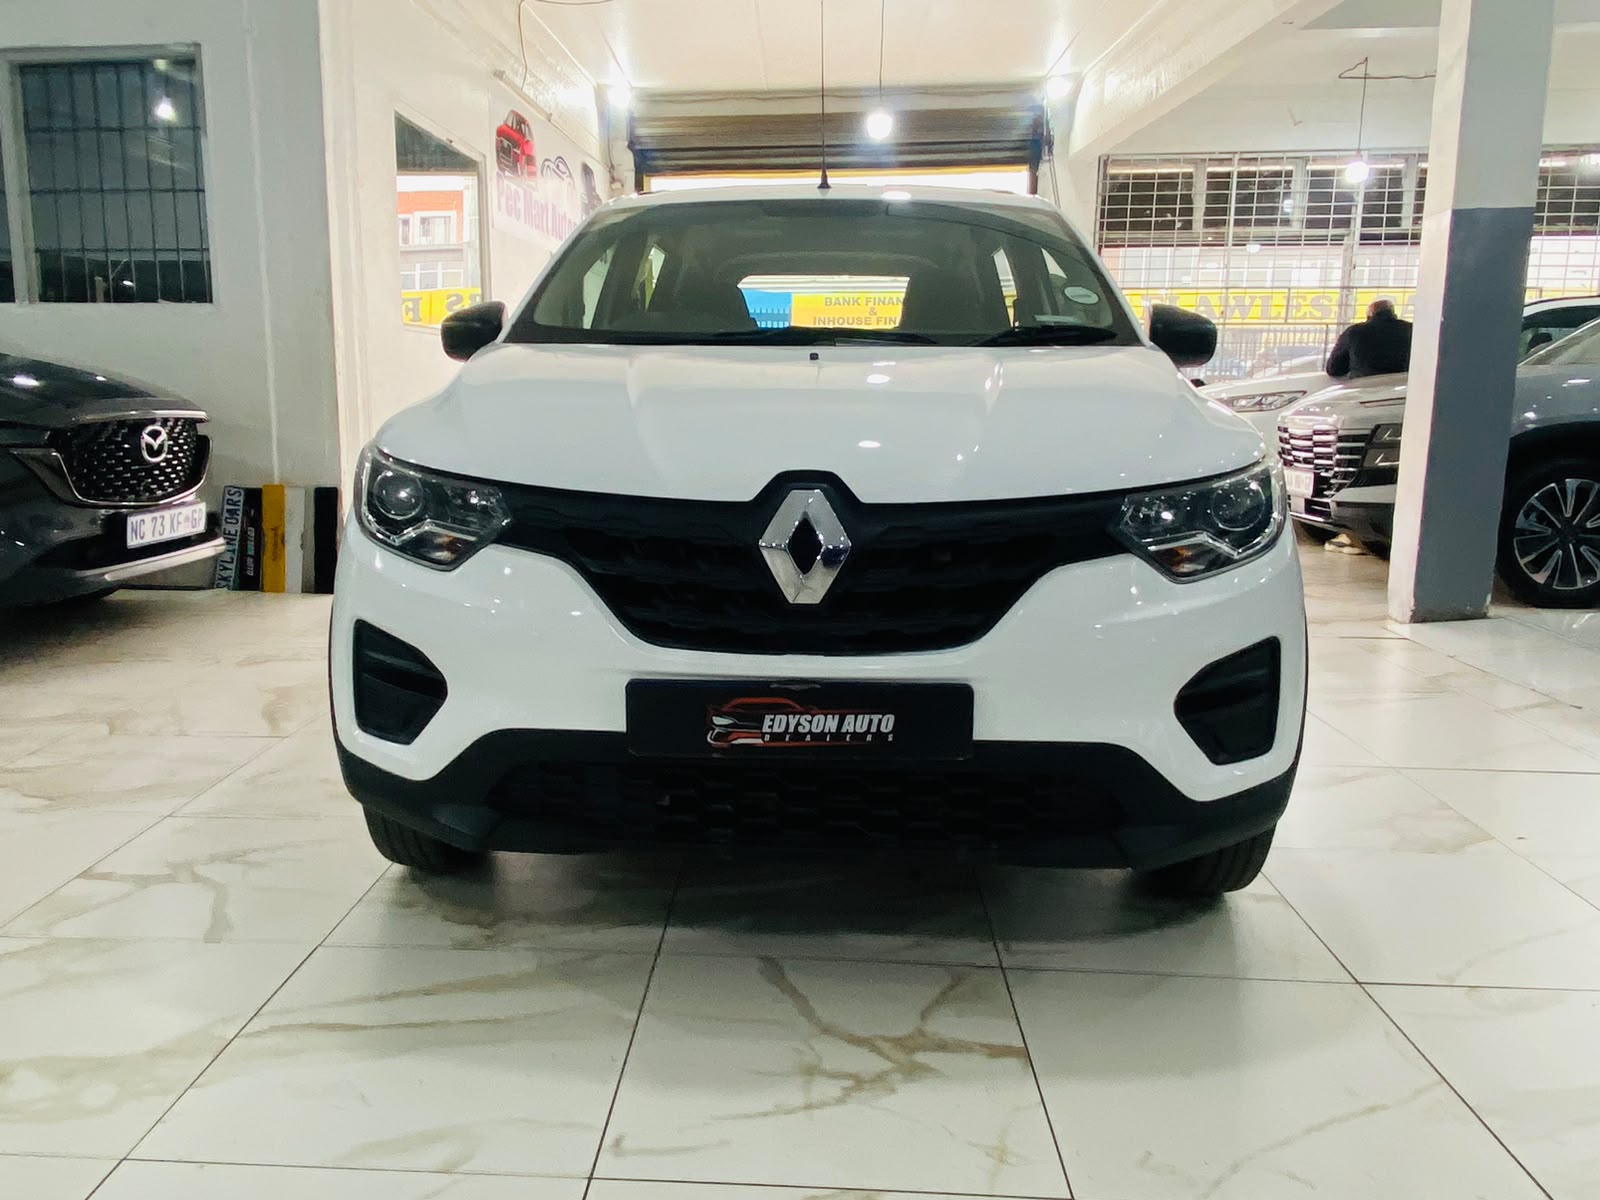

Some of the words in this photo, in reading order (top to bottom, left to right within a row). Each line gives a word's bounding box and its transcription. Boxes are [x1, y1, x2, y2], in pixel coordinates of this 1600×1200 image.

[825, 297, 861, 307] BANK
[868, 307, 878, 316] &
[813, 316, 873, 326] INHOUSE
[876, 317, 897, 326] FIN
[131, 519, 146, 541] NC
[151, 515, 166, 538] 73
[169, 511, 183, 534] KF
[762, 714, 839, 733] EDYSON
[841, 713, 896, 733] AUTO
[764, 733, 894, 742] DEALERS
